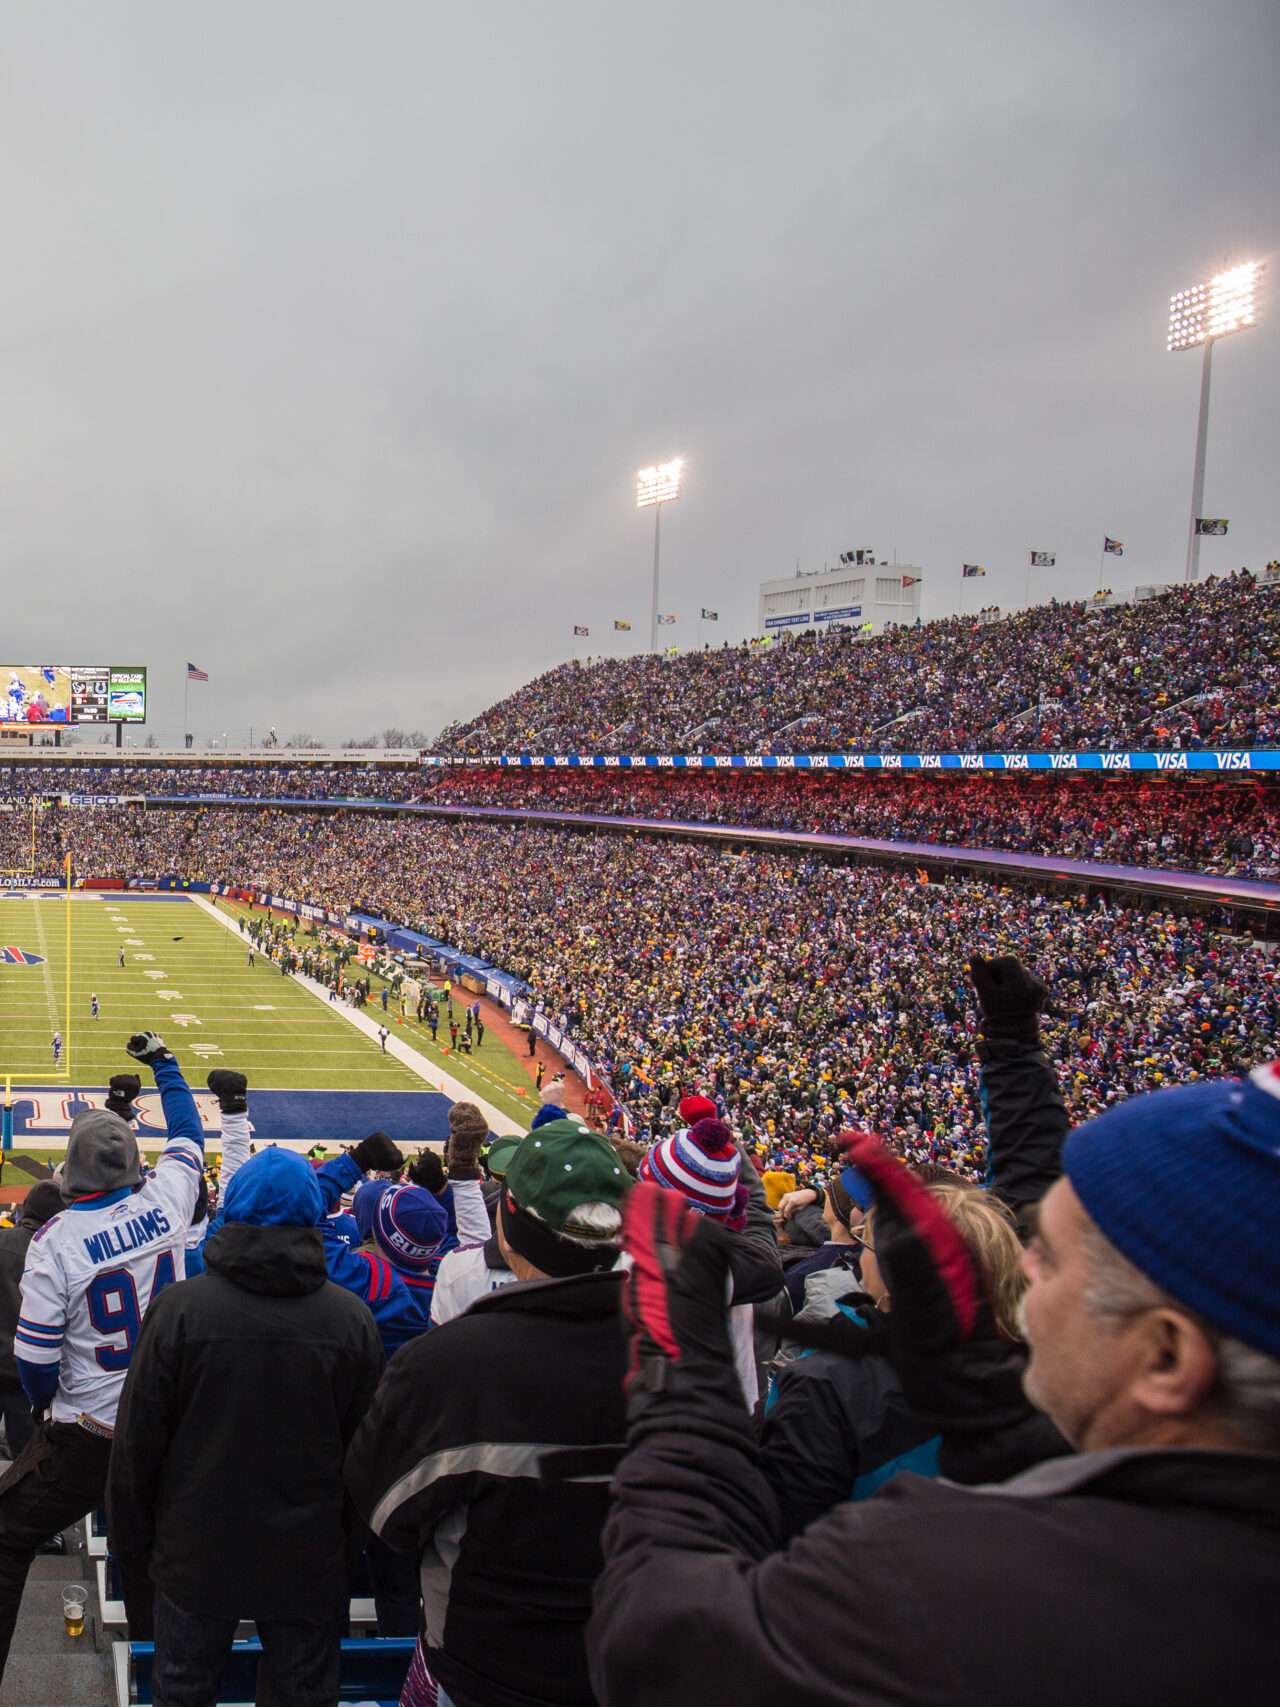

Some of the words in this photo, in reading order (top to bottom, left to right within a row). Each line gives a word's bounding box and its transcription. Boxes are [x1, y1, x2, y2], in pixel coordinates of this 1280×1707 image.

[507, 757, 521, 765] VISA
[530, 757, 544, 765] VISA
[554, 757, 569, 765] VISA
[579, 757, 594, 765] VISA
[604, 757, 619, 765] VISA
[630, 757, 646, 765] VISA
[657, 757, 674, 765] VISA
[685, 757, 702, 765] VISA
[714, 757, 732, 765] VISA
[744, 757, 762, 765] VISA
[776, 757, 795, 766] VISA
[809, 756, 829, 766] VISA
[843, 756, 864, 766] VISA
[880, 756, 902, 767] VISA
[918, 756, 941, 767] VISA
[959, 755, 984, 767] VISA
[1002, 755, 1029, 767] VISA
[1049, 755, 1077, 768] VISA
[1100, 754, 1130, 768] VISA
[1154, 754, 1187, 768] VISA
[1215, 753, 1251, 769] VISA
[6, 796, 27, 804] AND
[69, 796, 119, 806] GEICO
[83, 1207, 170, 1265] WILLIAMS
